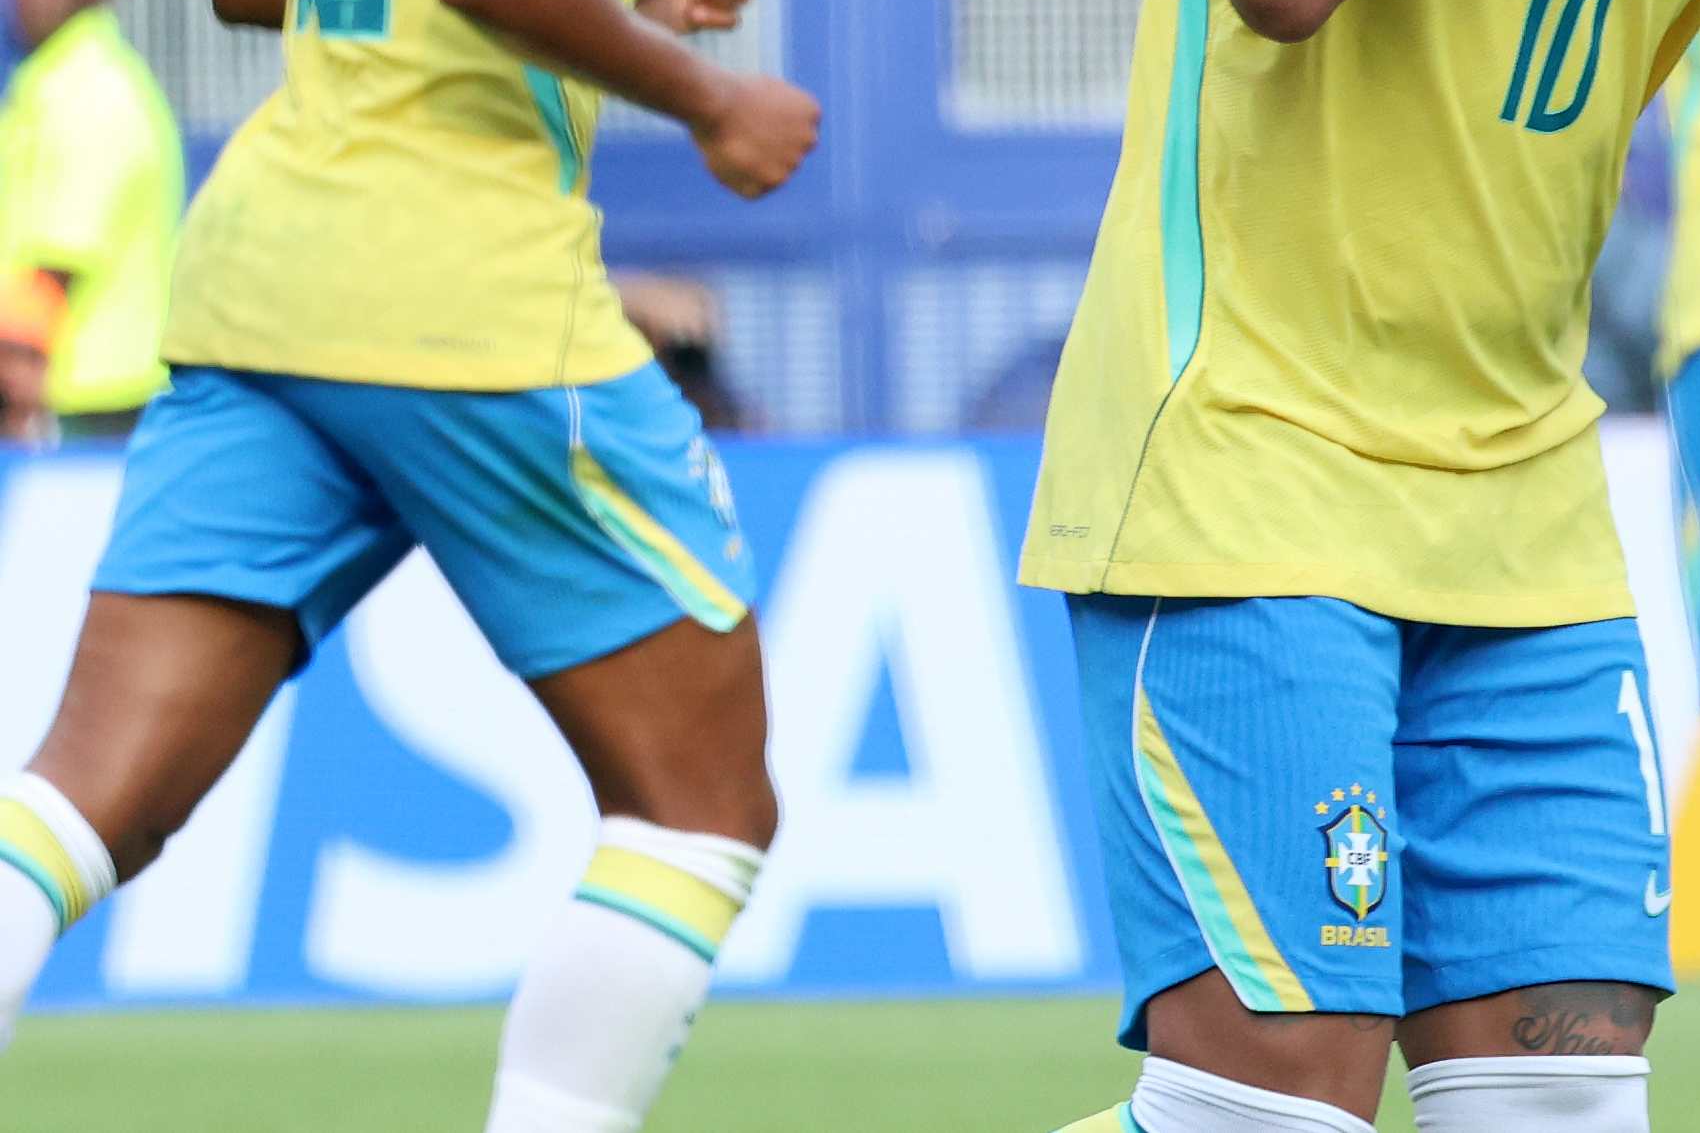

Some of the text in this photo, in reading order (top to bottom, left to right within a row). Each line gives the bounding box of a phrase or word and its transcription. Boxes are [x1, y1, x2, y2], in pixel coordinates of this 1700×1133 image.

[0, 446, 1088, 998] ISA
[1347, 851, 1372, 865] CBF
[1320, 924, 1391, 947] BRASIL
